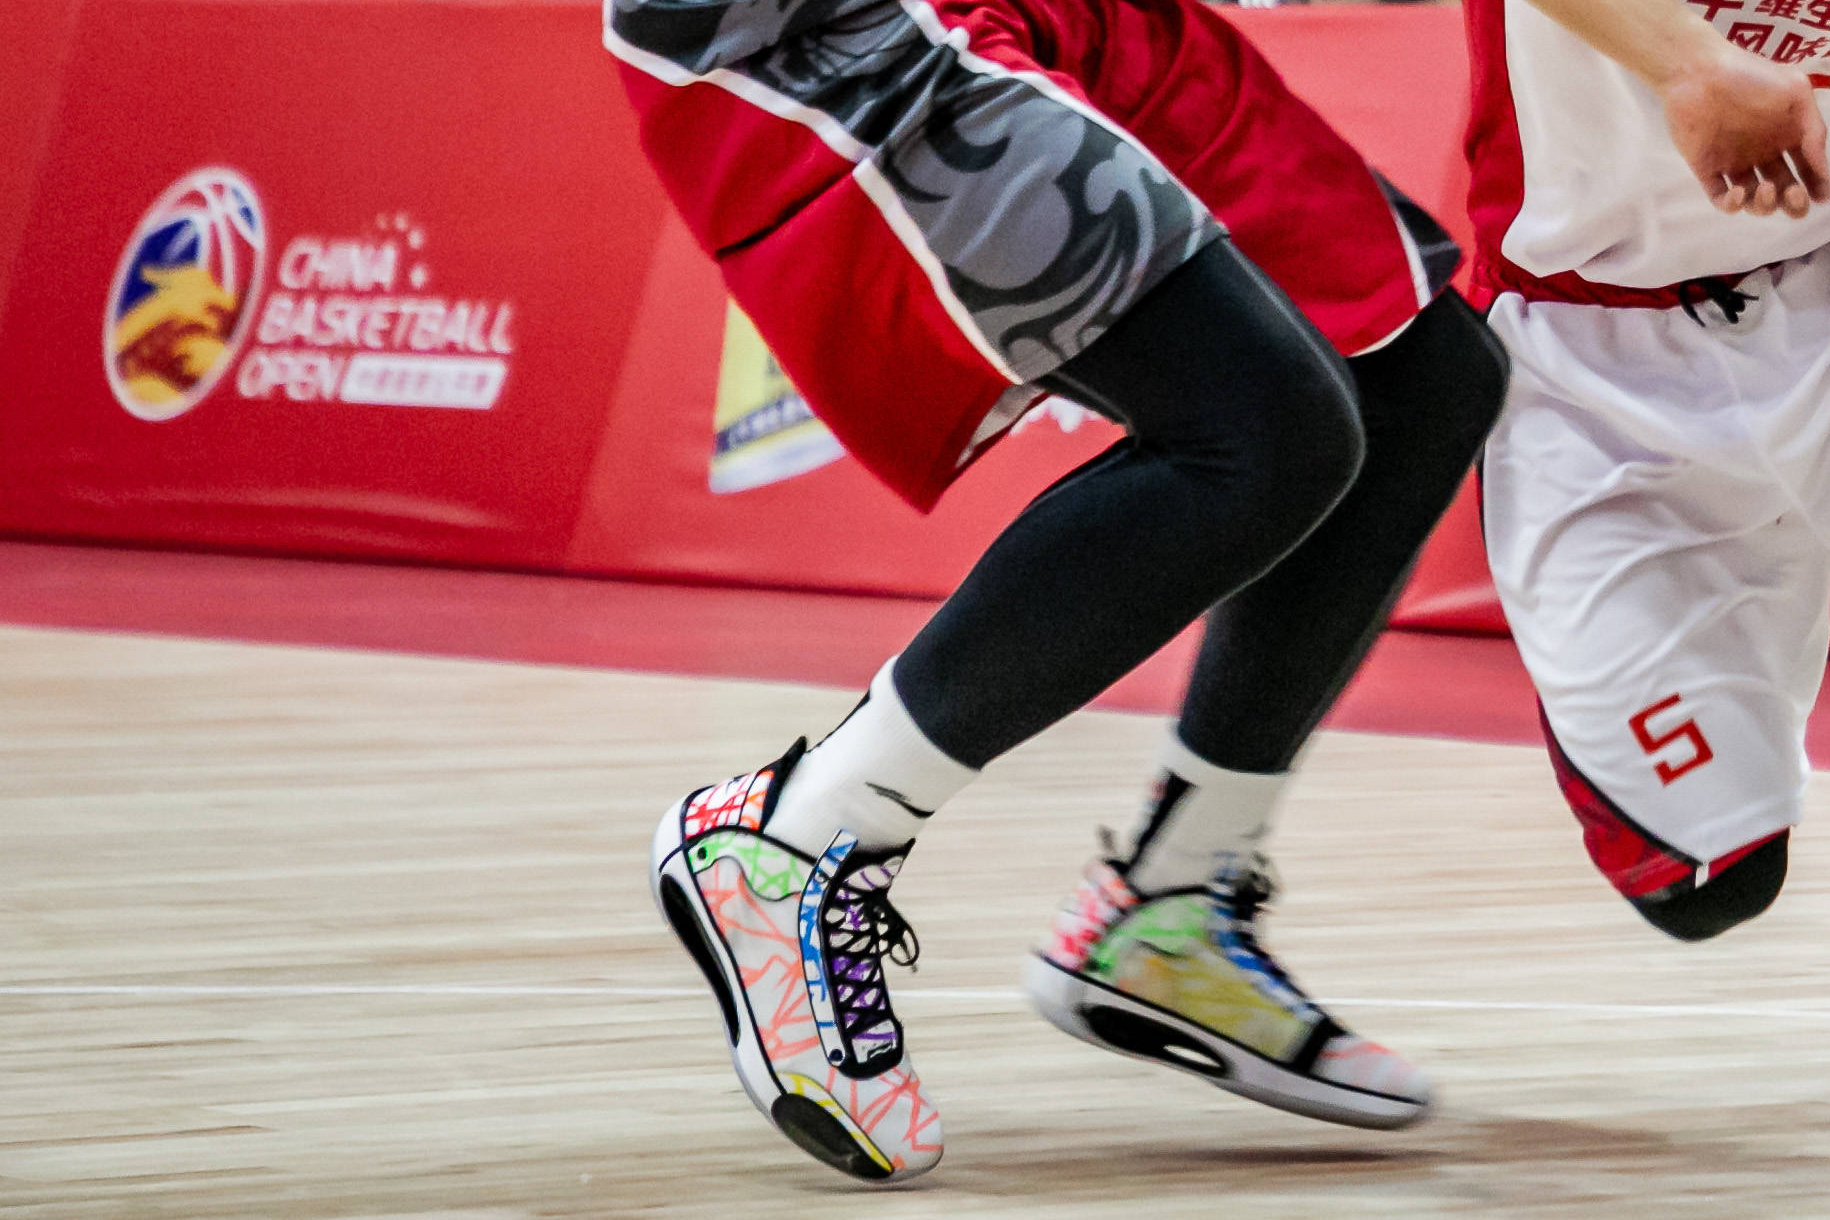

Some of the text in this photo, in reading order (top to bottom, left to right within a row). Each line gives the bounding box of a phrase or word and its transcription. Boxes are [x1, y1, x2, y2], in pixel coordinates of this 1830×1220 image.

[279, 236, 398, 292] CHINA
[257, 292, 513, 354] BASKETBALL
[237, 348, 346, 402] OPEN
[1628, 691, 1714, 788] 5
